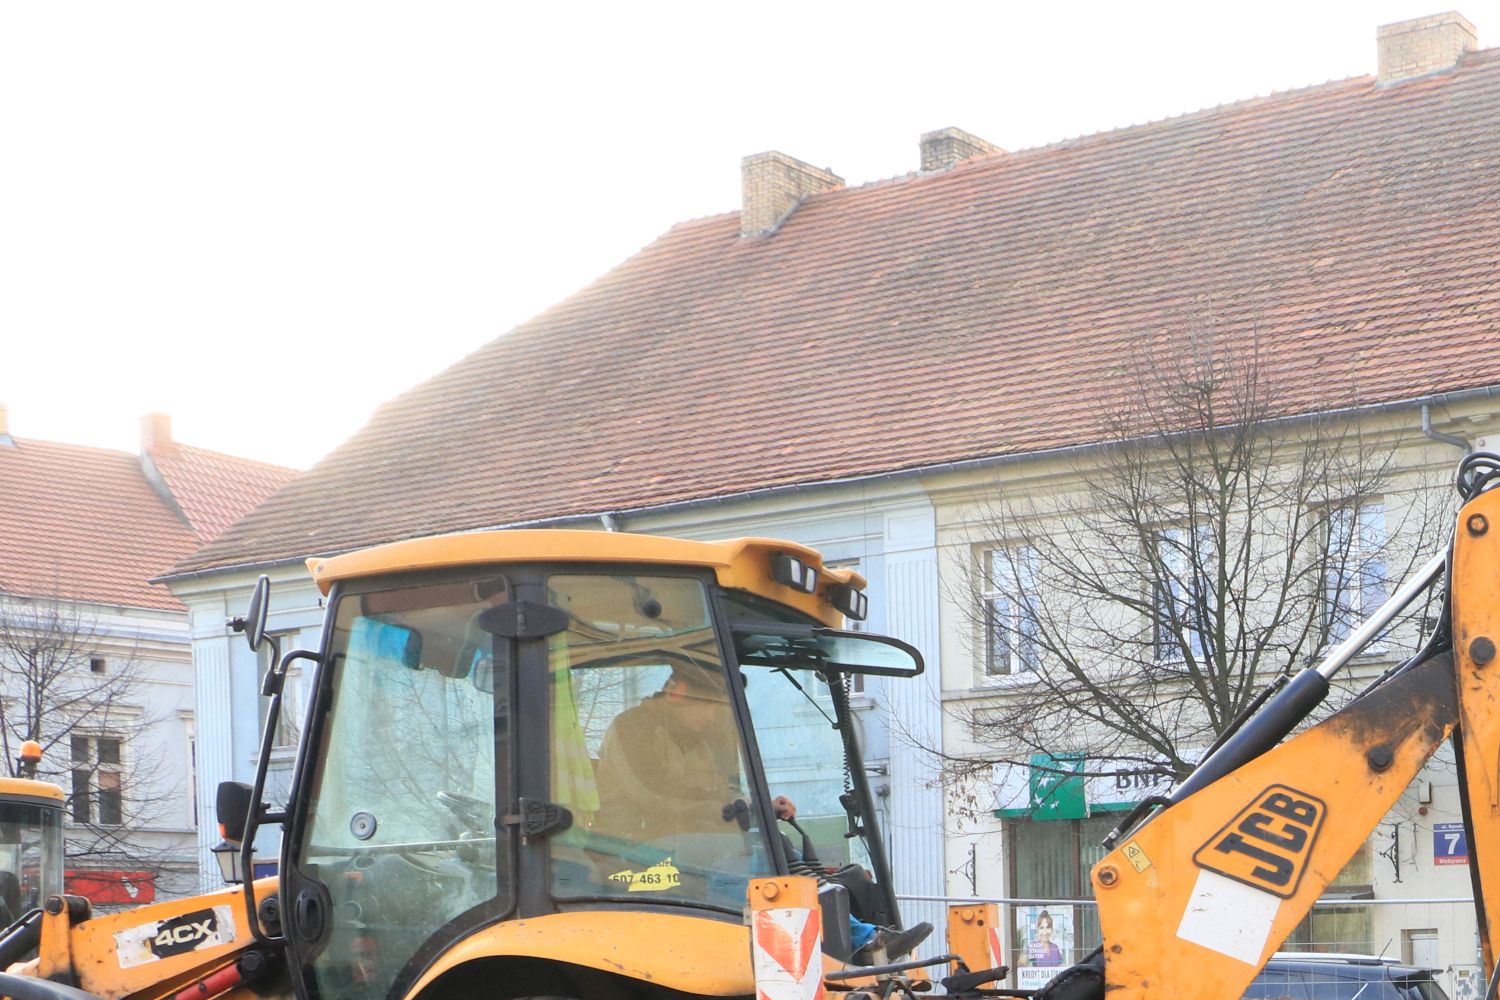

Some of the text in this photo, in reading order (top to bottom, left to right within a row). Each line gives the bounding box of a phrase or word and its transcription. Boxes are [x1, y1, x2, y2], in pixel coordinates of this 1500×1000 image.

[1214, 793, 1317, 886] JCB
[1445, 833, 1460, 855] 7
[640, 873, 661, 884] 463
[155, 919, 213, 946] 4CX
